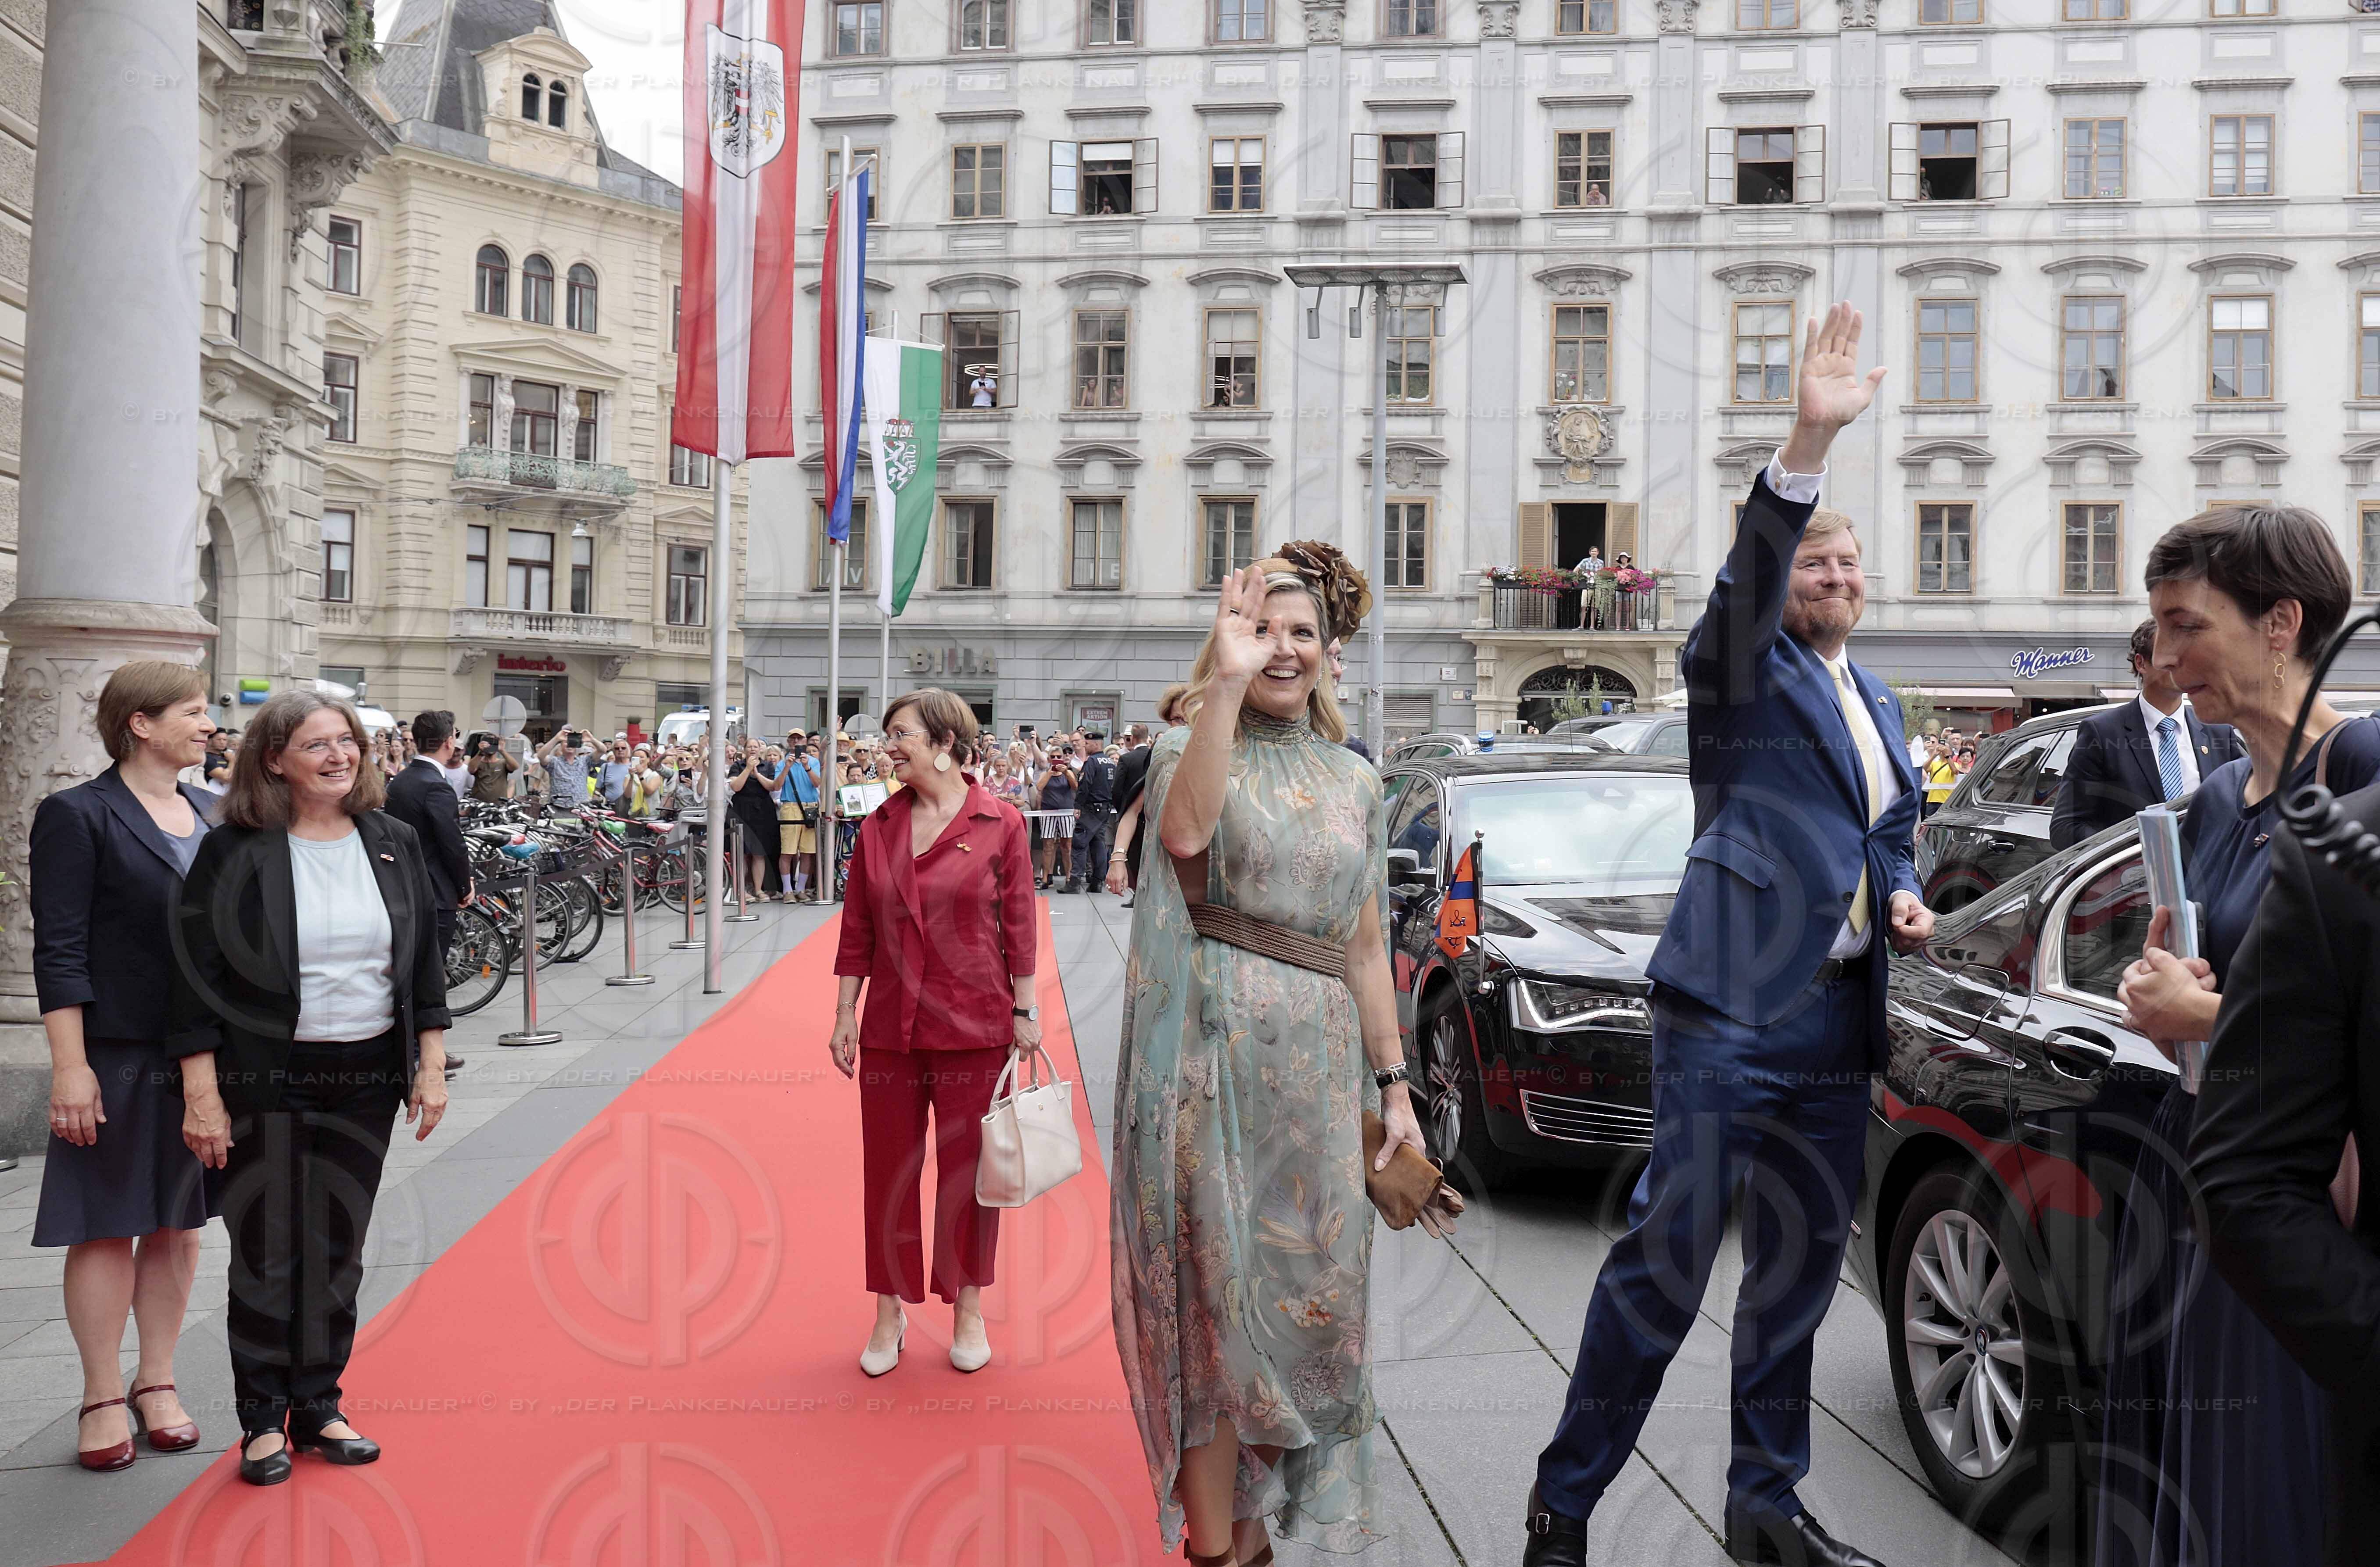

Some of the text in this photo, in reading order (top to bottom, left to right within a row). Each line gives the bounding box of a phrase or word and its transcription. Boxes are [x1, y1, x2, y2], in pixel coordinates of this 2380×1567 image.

[497, 653, 566, 672] interio
[910, 647, 997, 673] BILLA
[2011, 647, 2095, 678] Manner
